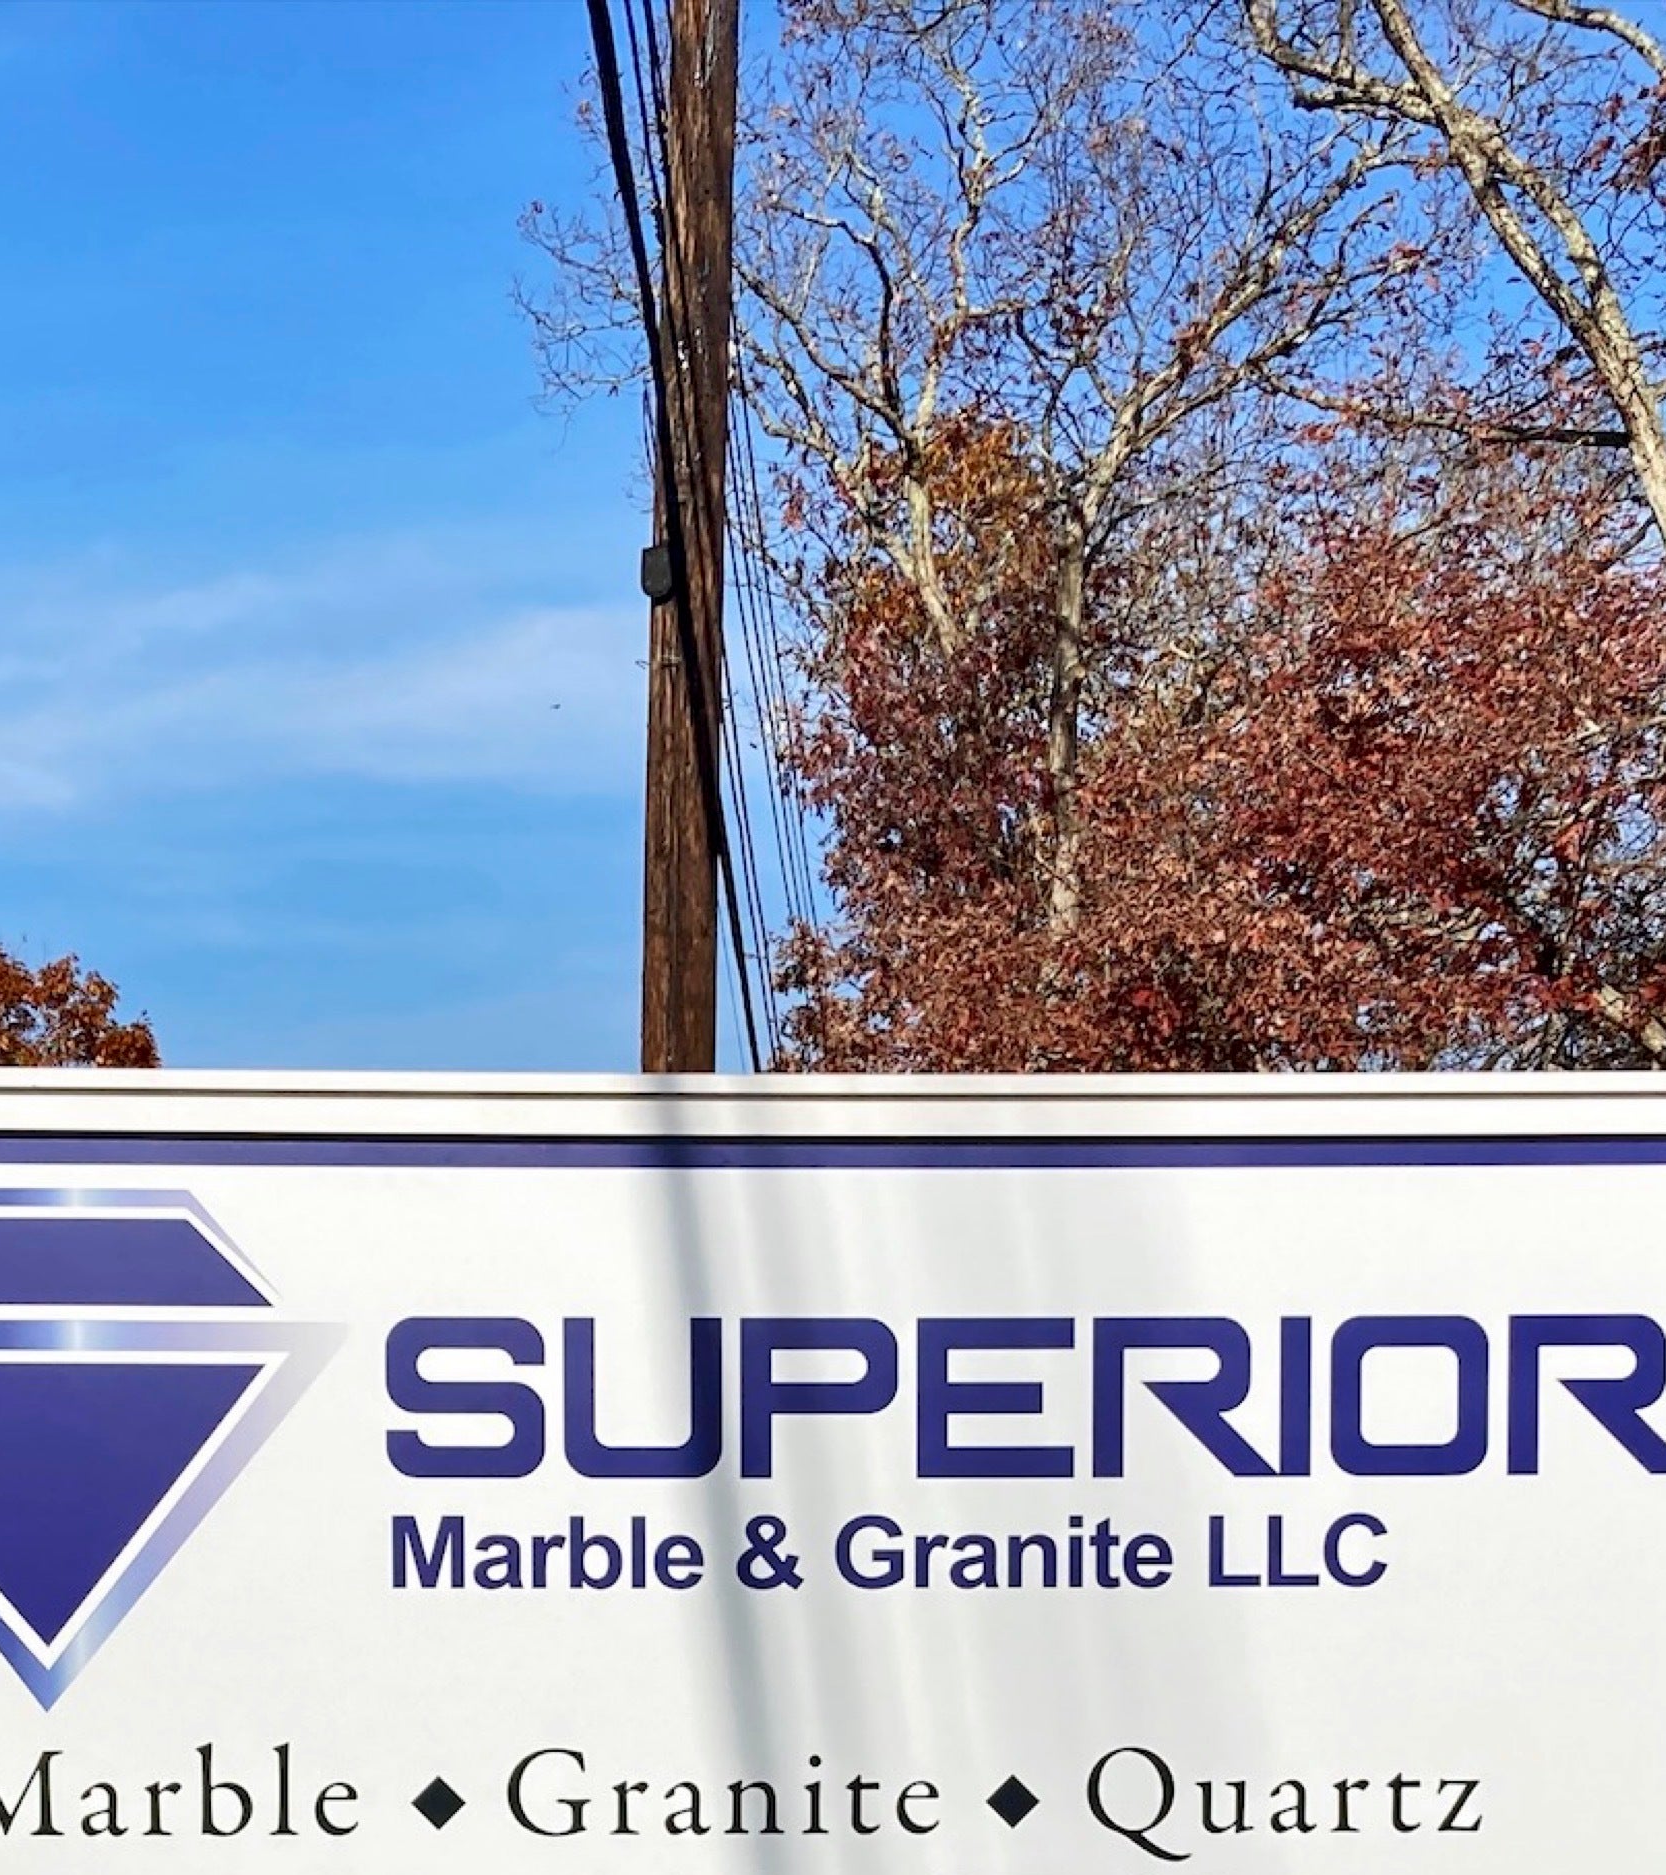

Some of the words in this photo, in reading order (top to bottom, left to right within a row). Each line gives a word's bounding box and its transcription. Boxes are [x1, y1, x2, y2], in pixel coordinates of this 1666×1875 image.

[391, 1514, 705, 1591] Marble
[735, 1514, 805, 1591] &
[833, 1514, 1174, 1591] Granite
[1207, 1512, 1389, 1589] LLC
[506, 1748, 940, 1837] Granite
[1086, 1746, 1483, 1862] Quartz
